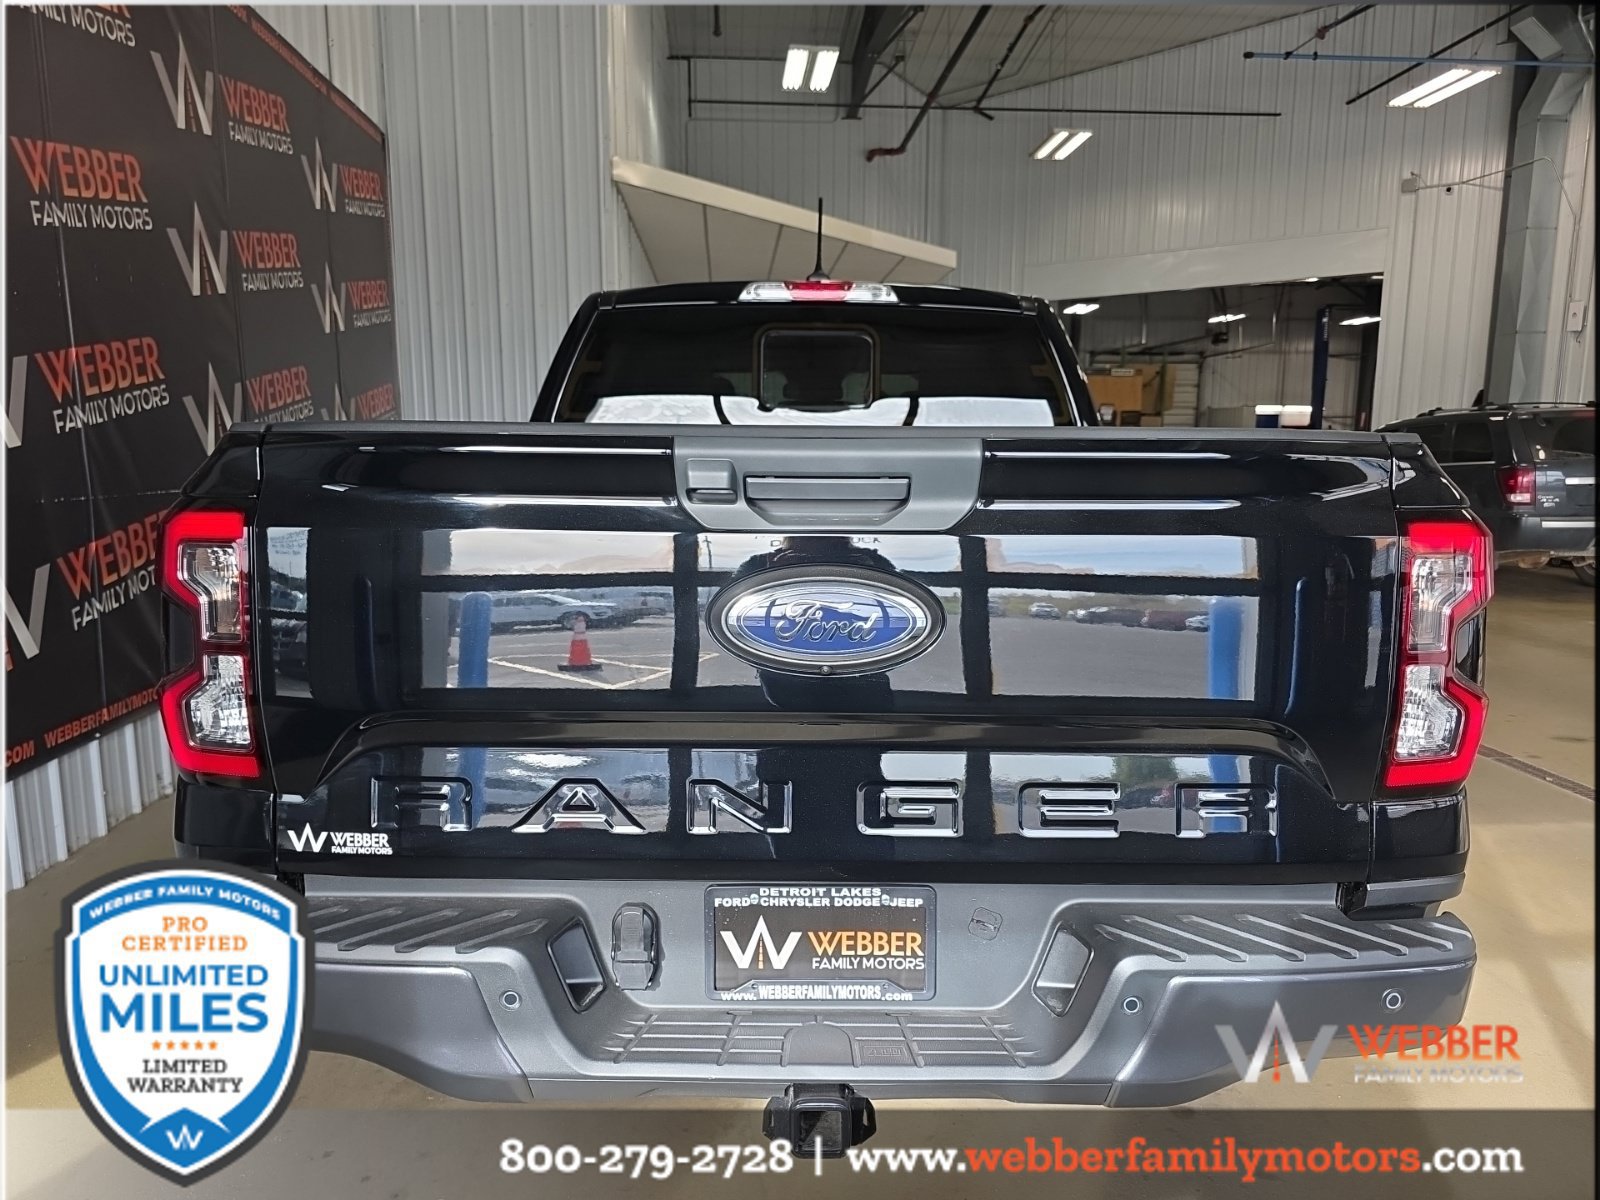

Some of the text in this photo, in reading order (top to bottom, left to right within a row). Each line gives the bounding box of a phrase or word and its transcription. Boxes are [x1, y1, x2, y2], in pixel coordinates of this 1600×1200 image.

[70, 5, 136, 47] MOTORS
[219, 74, 290, 134] WEBBER
[228, 121, 294, 155] FAMILY MOTORS
[10, 135, 149, 203] WEBBER
[339, 164, 384, 202] WEBBER
[30, 200, 153, 231] FAMILY MOTORS
[232, 230, 302, 269] WEBBER
[241, 271, 304, 292] FAMILY MOTORS
[346, 279, 391, 311] WEBBER
[34, 336, 166, 404] WEBBER
[53, 385, 171, 434] FAMILY MOTORS
[246, 365, 312, 415] WEBBER
[57, 509, 168, 600] WEBBE
[71, 565, 157, 631] FAMILY MOT
[775, 598, 880, 643] Ford
[44, 688, 158, 749] WEBBERFAMILYMOTO
[371, 777, 1278, 838] RANGER
[329, 832, 389, 848] WEBBER
[331, 846, 393, 855] FAMILY MOTORS
[714, 897, 924, 908] FORD CHRYSLER DODGE JEEP
[759, 887, 882, 898] DETROIT LAKES
[808, 931, 925, 957] WEBBER
[812, 957, 925, 970] FAMILY MOTORS
